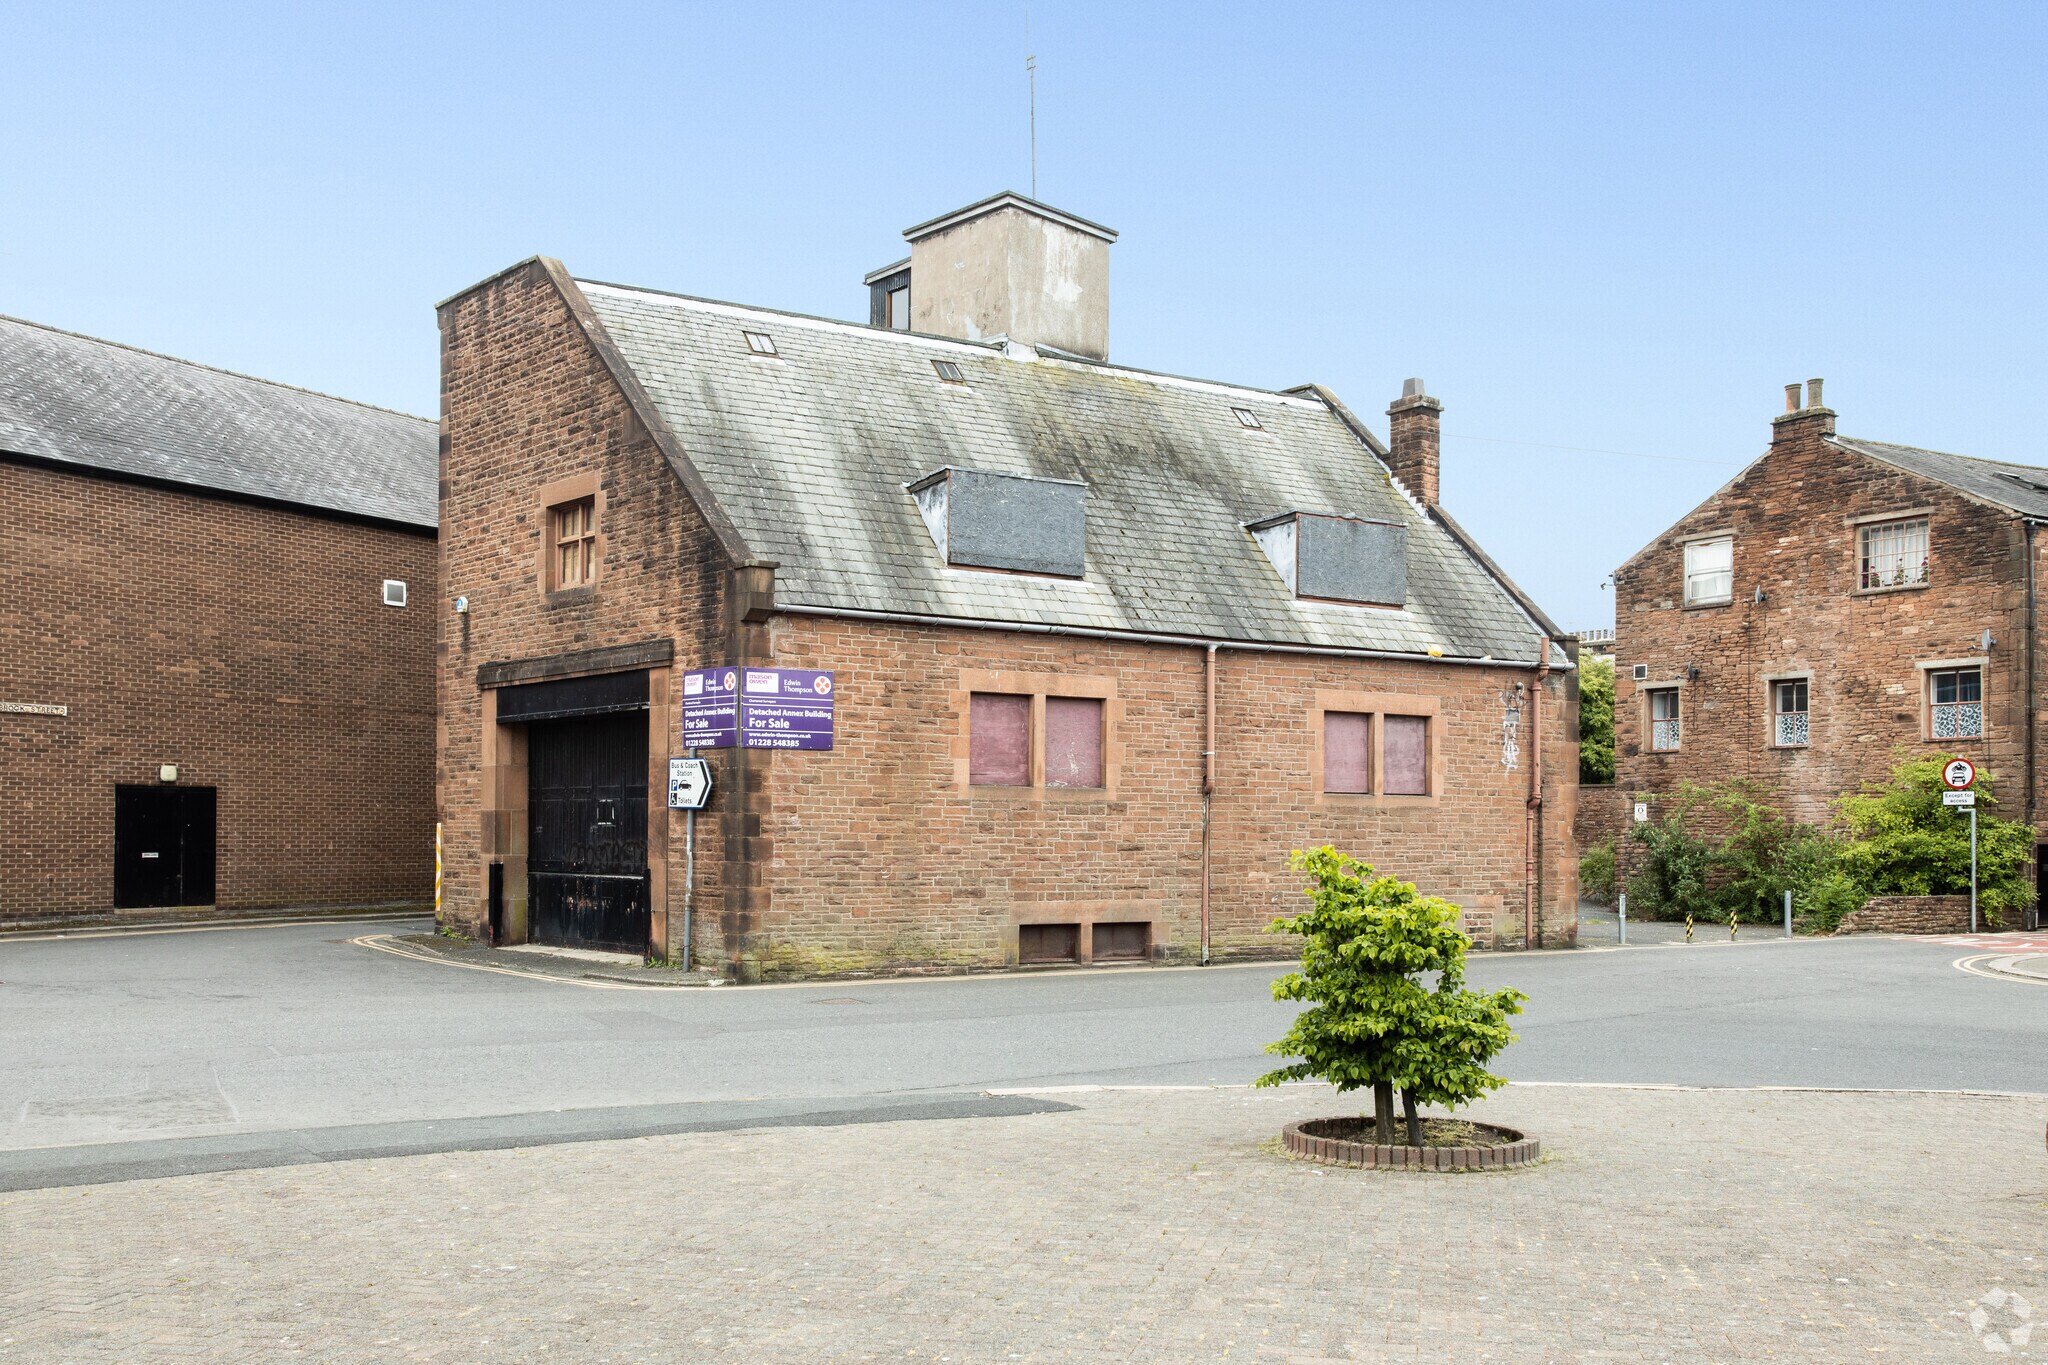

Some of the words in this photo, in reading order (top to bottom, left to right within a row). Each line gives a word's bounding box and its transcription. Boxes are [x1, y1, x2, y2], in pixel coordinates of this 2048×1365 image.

[784, 686, 813, 694] Thompson
[685, 709, 704, 717] Detached
[717, 707, 735, 716] Building
[749, 708, 782, 716] Detached
[804, 710, 832, 720] Building
[685, 720, 695, 729] For
[696, 718, 708, 728] Sale
[749, 718, 766, 728] For
[768, 718, 790, 728] Sale
